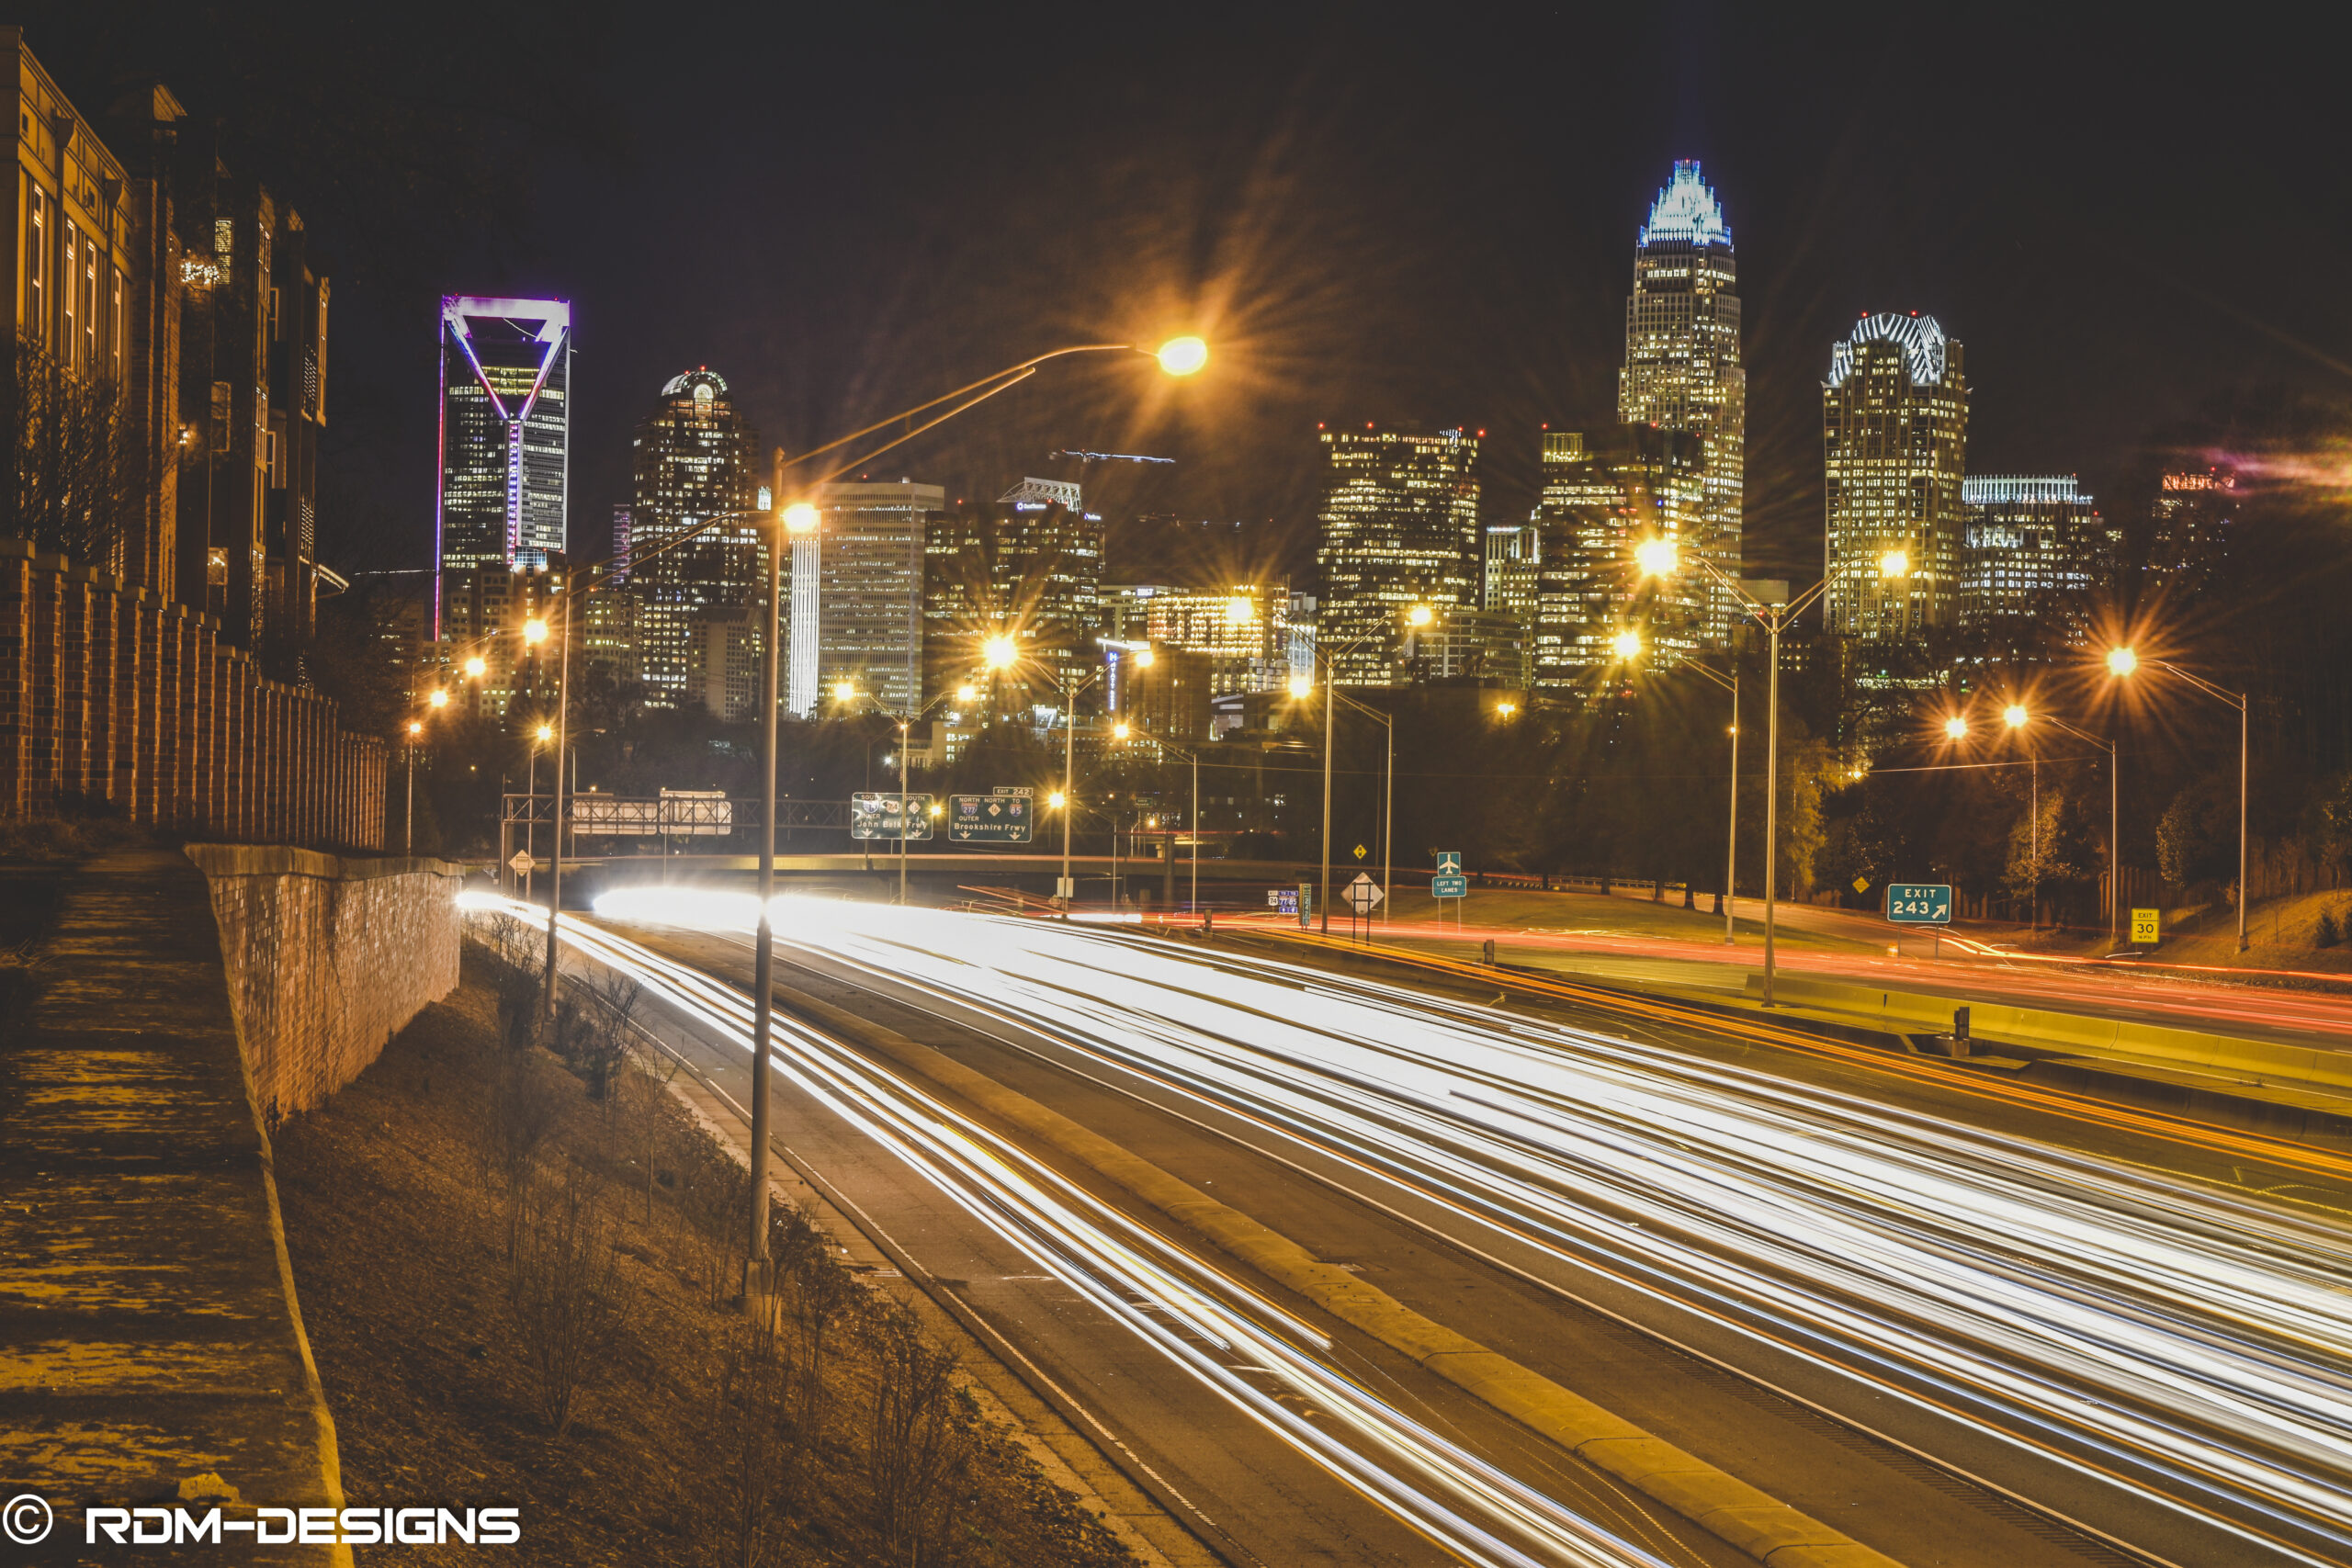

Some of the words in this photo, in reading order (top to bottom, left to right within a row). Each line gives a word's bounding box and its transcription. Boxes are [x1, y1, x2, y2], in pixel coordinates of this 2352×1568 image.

[1005, 824, 1026, 833] Frwy
[1905, 889, 1936, 898] EXIT
[1893, 901, 1929, 914] 243
[2137, 924, 2154, 933] 30
